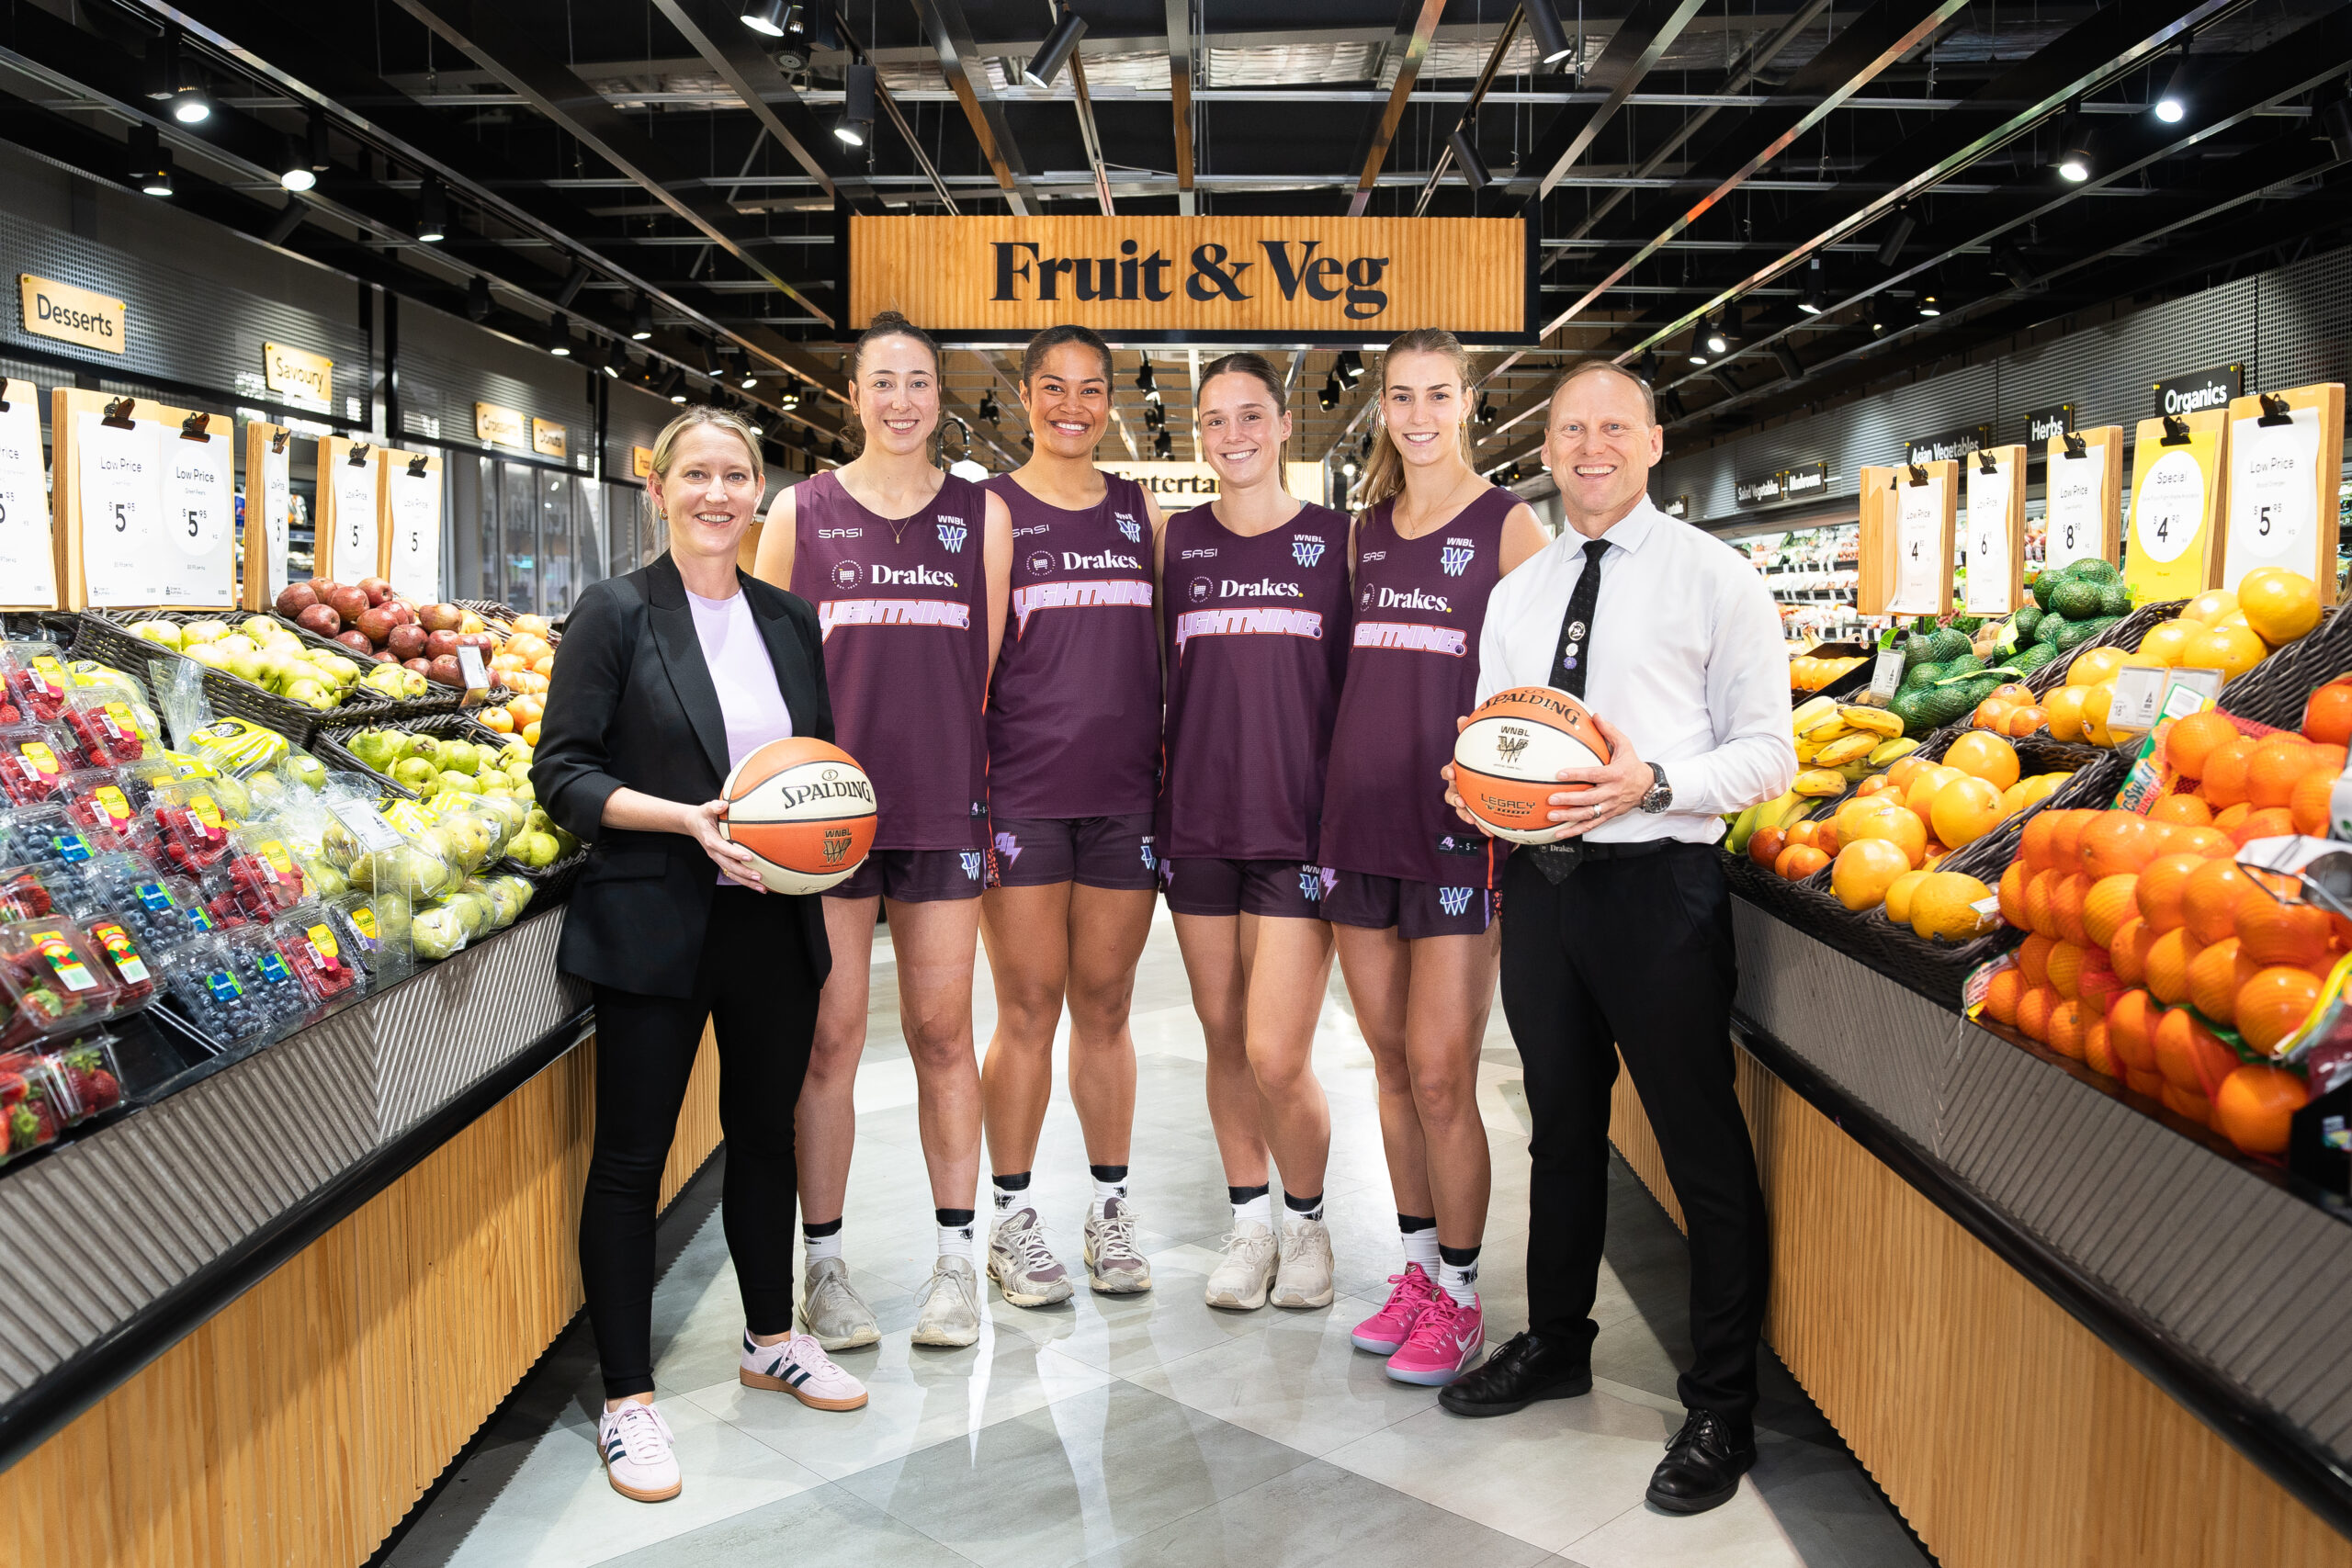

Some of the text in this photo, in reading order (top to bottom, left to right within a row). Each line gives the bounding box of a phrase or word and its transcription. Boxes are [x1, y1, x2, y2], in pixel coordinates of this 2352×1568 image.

[989, 239, 1388, 320] Fruit & Veg
[37, 293, 112, 337] Desserts
[276, 356, 323, 392] Savoury
[2165, 380, 2227, 414] Organics
[2031, 415, 2064, 441] Herbs
[0, 446, 19, 459] rice
[1911, 435, 1979, 465] Asian Vegetables
[101, 456, 142, 472] Low Price
[175, 466, 215, 483] Low Price
[2249, 457, 2294, 474] Low Price
[2156, 470, 2188, 485] Special
[1738, 479, 1780, 502] Salad Vegetables
[2073, 485, 2088, 497] Price
[115, 503, 126, 532] 5
[188, 511, 198, 537] 5
[937, 514, 967, 526] WNBL
[2259, 506, 2270, 536] 5
[352, 525, 359, 547] 5
[818, 527, 863, 539] SASI
[1012, 524, 1050, 538] SASI
[1294, 534, 1325, 543] WNBL
[2066, 525, 2074, 549] 8
[2156, 517, 2168, 543] 4
[411, 531, 418, 552] 5
[1446, 536, 1476, 547] WNBL
[1911, 541, 1918, 561] 4
[1981, 533, 1987, 555] 6
[1061, 549, 1142, 570] Drakes.
[1181, 547, 1218, 559] SASI
[1363, 550, 1386, 563] SASI
[870, 564, 958, 588] Drakes.
[1219, 578, 1304, 597] Drakes.
[1377, 588, 1452, 613] Drakes.
[818, 598, 971, 645] LIGHTNING
[1175, 606, 1324, 657] LIGHTNING
[1480, 692, 1581, 726] SPALDING
[1500, 725, 1531, 737] WNBL
[781, 781, 873, 809] SPALDING
[1480, 793, 1536, 809] LEGACY
[824, 828, 853, 838] WNBL
